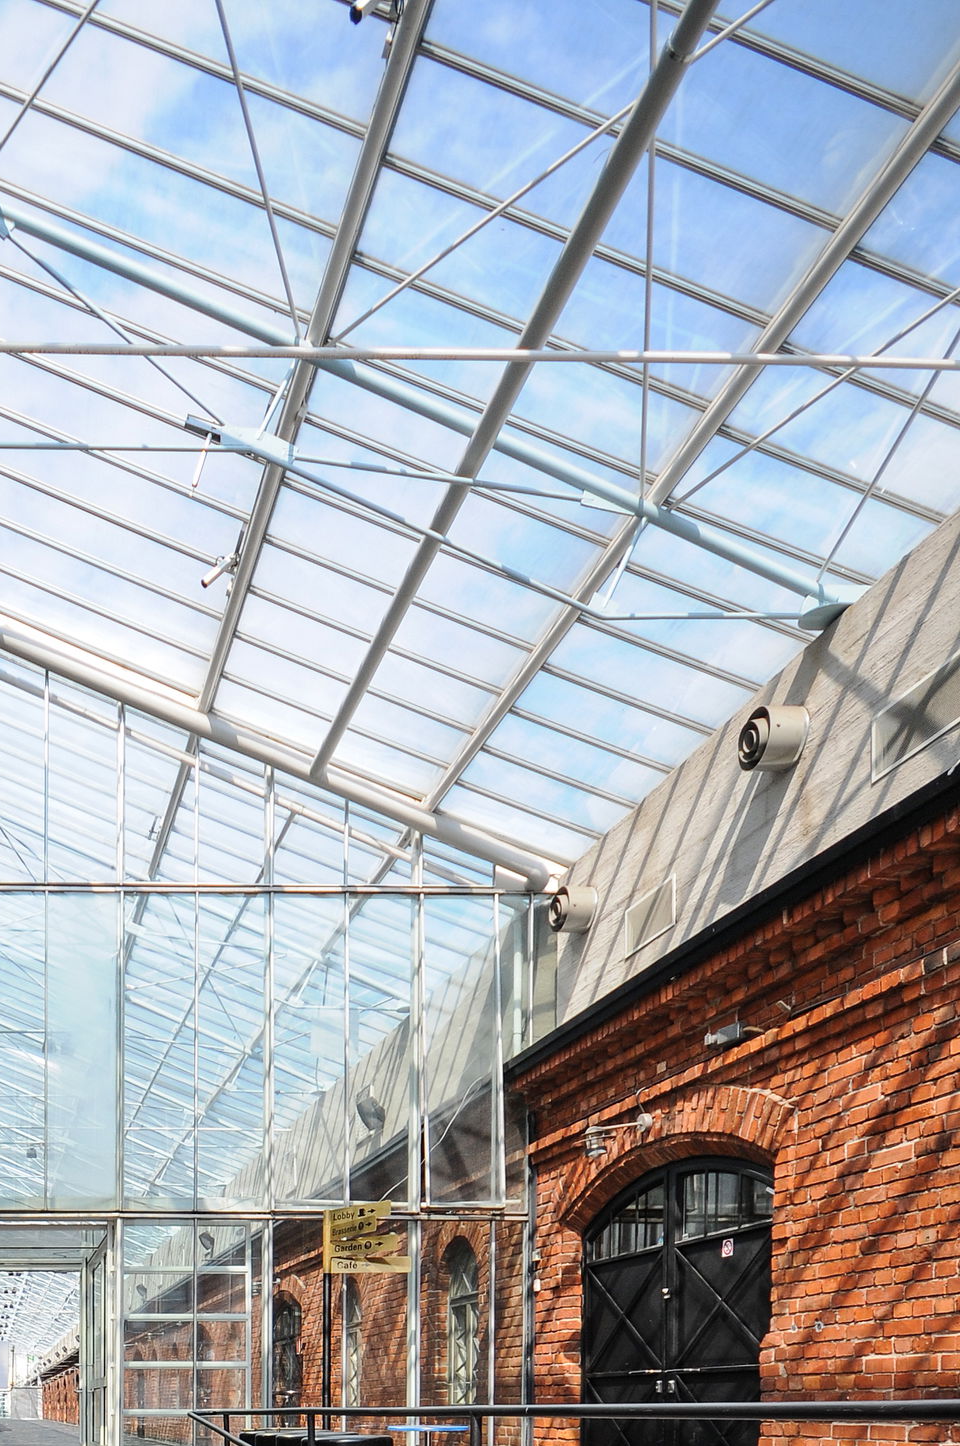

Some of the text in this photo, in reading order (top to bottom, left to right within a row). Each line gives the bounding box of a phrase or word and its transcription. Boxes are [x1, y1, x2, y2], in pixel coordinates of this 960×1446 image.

[333, 1212, 355, 1221] Lobby
[332, 1225, 357, 1237] Brasserie
[334, 1243, 363, 1252] Garden
